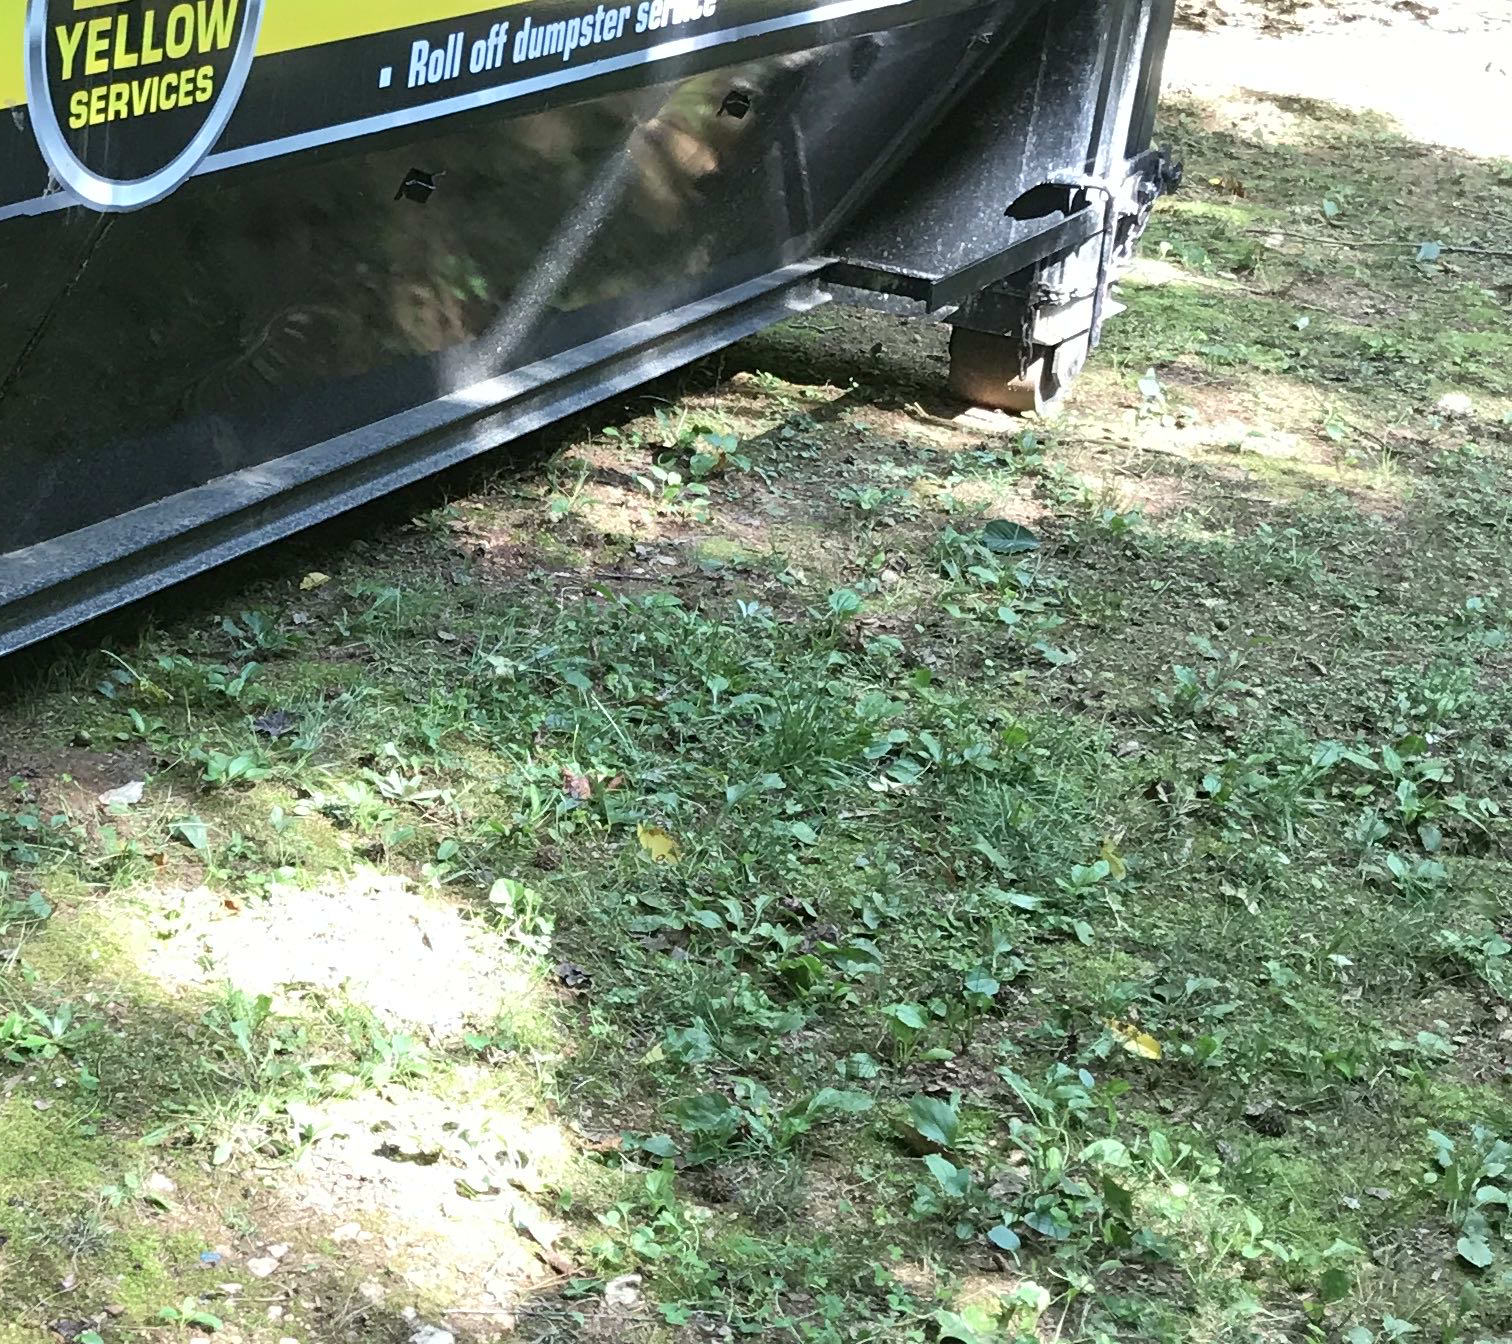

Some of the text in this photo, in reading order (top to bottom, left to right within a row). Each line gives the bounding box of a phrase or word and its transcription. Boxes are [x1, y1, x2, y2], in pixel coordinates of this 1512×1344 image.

[407, 32, 464, 88] Roll
[469, 23, 507, 74] off
[513, 4, 631, 61] dumpster
[68, 65, 214, 130] SERVICES
